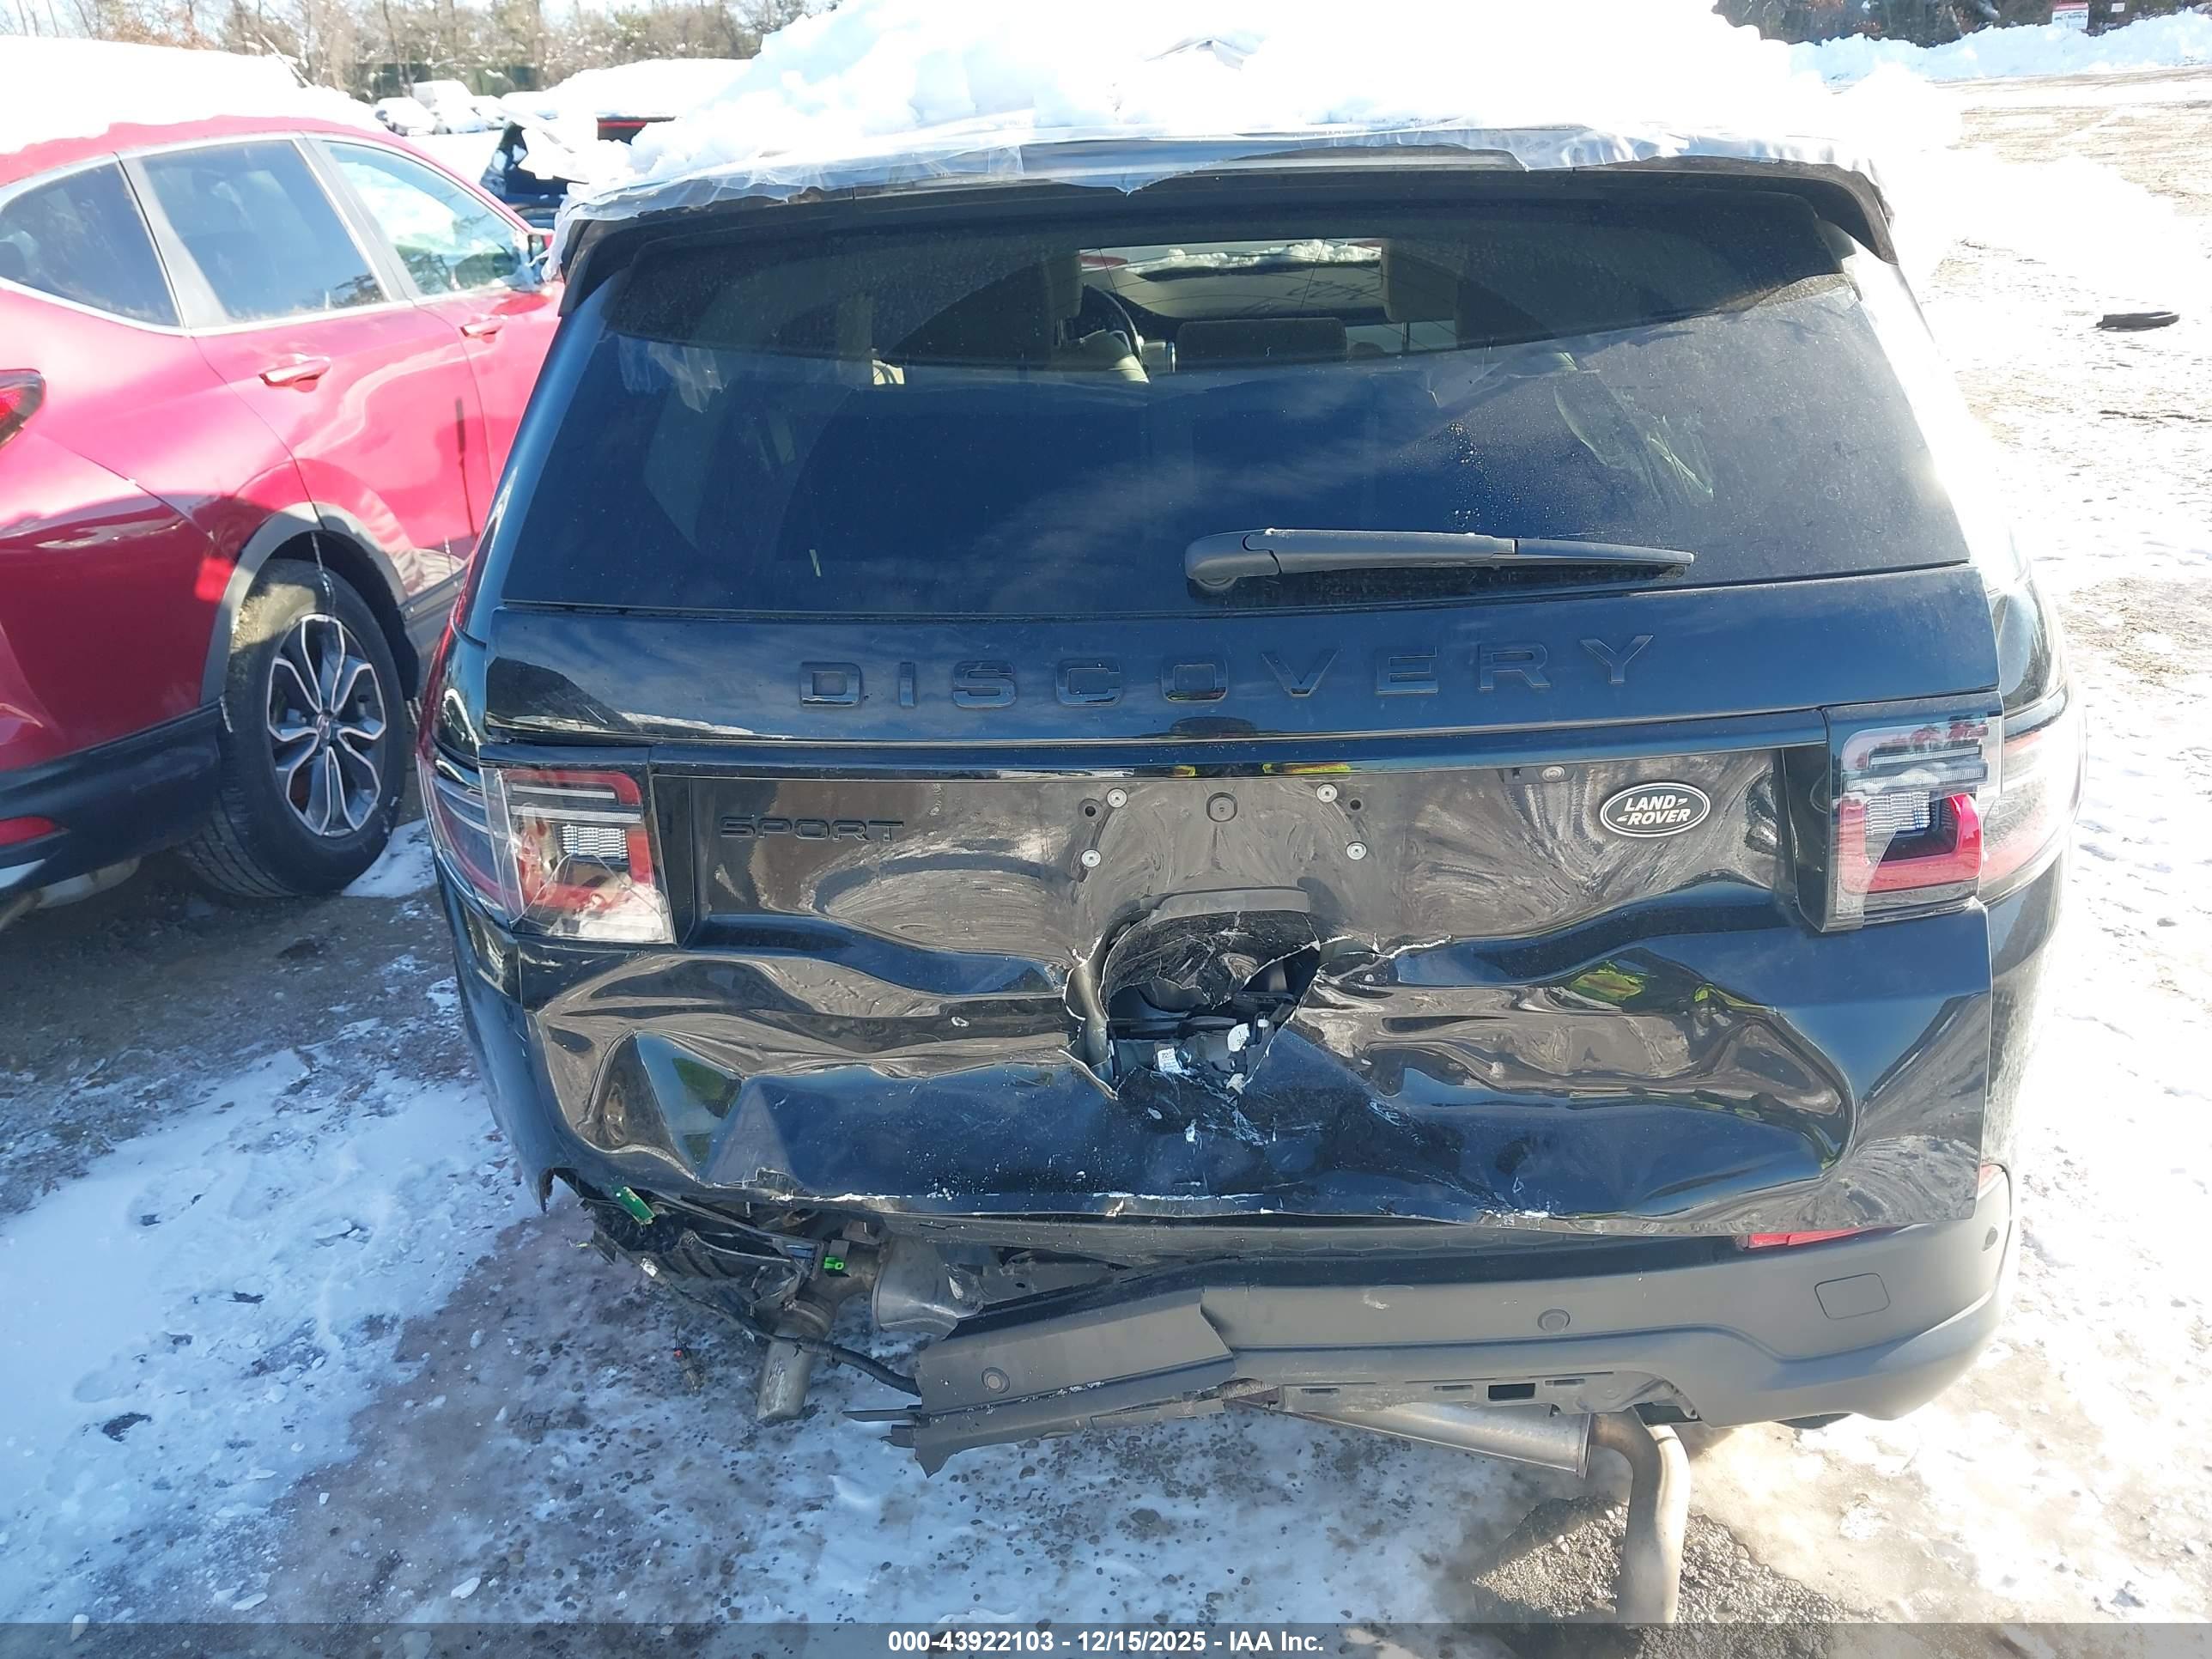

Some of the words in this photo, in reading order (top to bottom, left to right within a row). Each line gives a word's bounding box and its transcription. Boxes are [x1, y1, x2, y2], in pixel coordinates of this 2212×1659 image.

[799, 635, 1654, 708] DISCOVERY
[1626, 795, 1675, 811] LAND
[720, 817, 904, 842] SPORT
